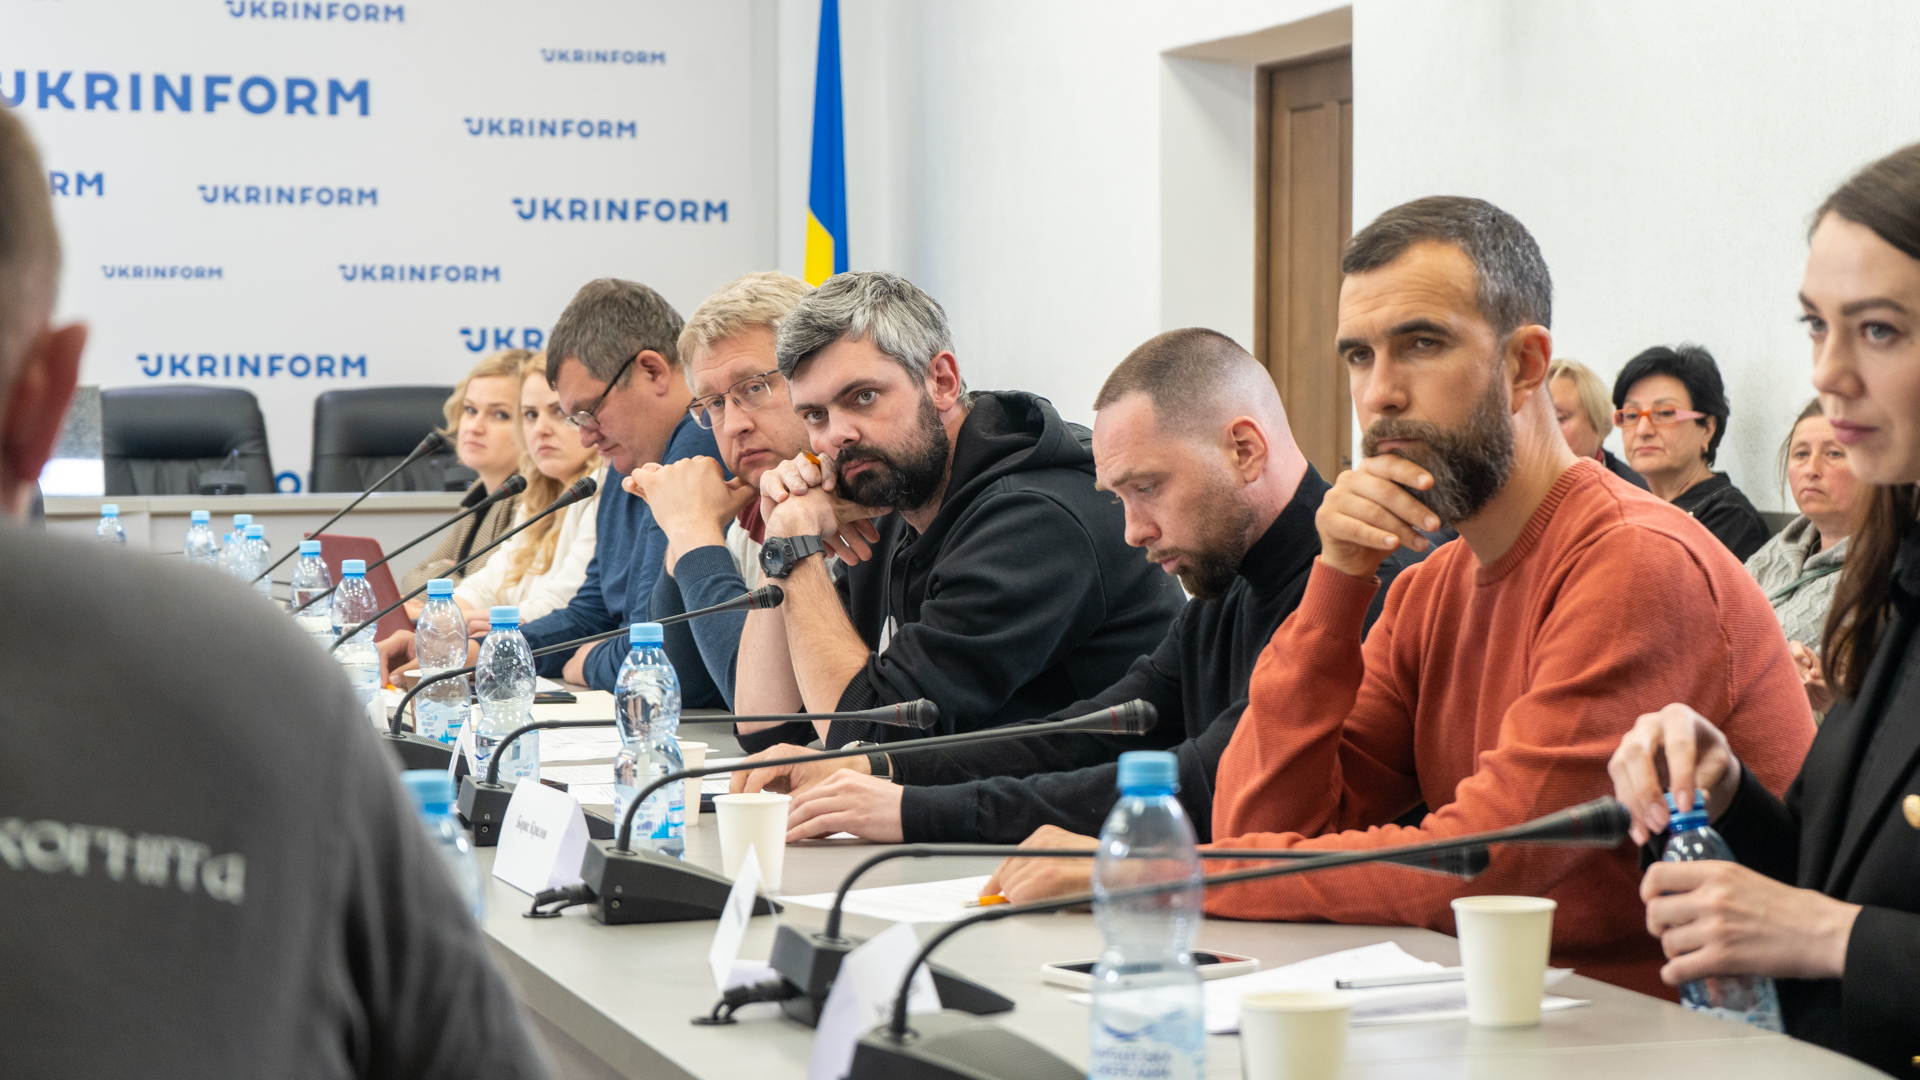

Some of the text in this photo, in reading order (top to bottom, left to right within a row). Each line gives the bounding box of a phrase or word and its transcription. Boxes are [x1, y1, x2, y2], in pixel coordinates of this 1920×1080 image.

[225, 0, 405, 22] UKRINFORM
[541, 48, 666, 65] UKRINFORM
[0, 70, 371, 117] UKRINFORM
[464, 117, 637, 139] UKRINFORM
[198, 185, 379, 206] UKRINFORM
[512, 197, 729, 223] UKRINFORM
[102, 264, 223, 280] UKRINFORM
[339, 264, 501, 283] UKRINFORM
[136, 353, 368, 379] UKRINFORM
